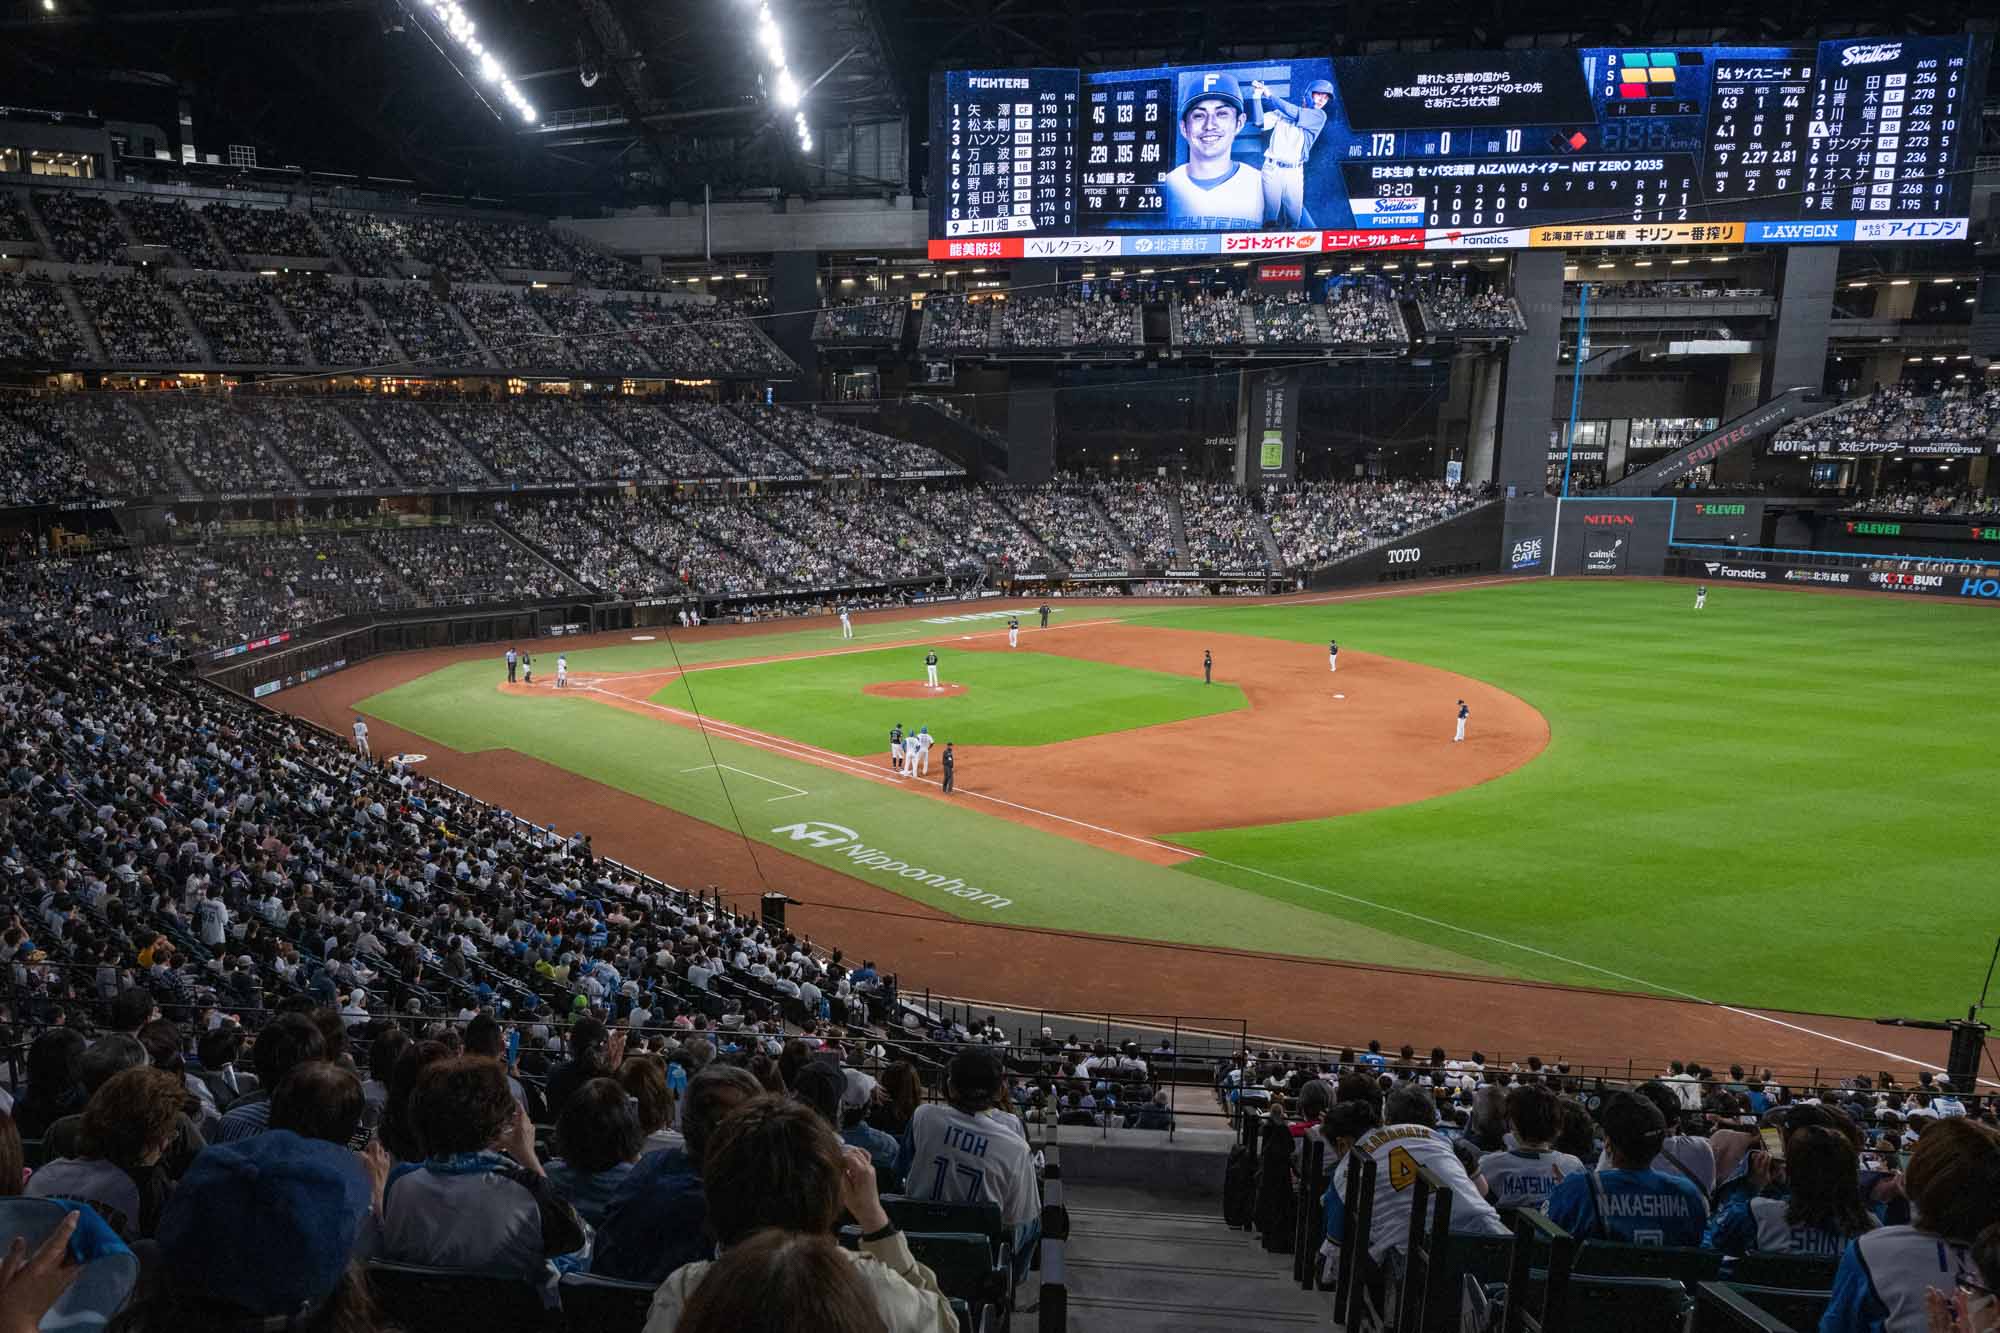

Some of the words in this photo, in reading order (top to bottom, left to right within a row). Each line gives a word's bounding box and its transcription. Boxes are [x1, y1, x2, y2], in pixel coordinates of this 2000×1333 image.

[1608, 55, 1616, 65] B
[1841, 45, 1901, 66] Swallows
[1917, 60, 1937, 69] AVG
[1949, 58, 1963, 67] HR
[1607, 70, 1615, 81] S
[1717, 68, 1731, 80] 54
[1734, 67, 1792, 79] サイスニード
[1913, 72, 1937, 84] .256
[968, 78, 1030, 89] FIGHTERS
[1203, 73, 1220, 92] F
[1718, 87, 1744, 95] PITCHES
[1755, 87, 1770, 95] HITS
[1780, 86, 1806, 94] STRIKES
[1911, 88, 1936, 100] .278
[1722, 97, 1738, 109] 63
[1783, 95, 1799, 108] 44
[1038, 104, 1057, 114] .190
[1092, 106, 1105, 124] 45
[1117, 104, 1133, 123] 133
[1145, 103, 1158, 122] 23
[1909, 104, 1934, 116] .452
[1038, 118, 1057, 129] .290
[1716, 124, 1735, 137] 4.1
[1753, 123, 1762, 137] 0
[1907, 120, 1931, 132] .224
[1941, 120, 1955, 131] 10
[968, 134, 1010, 146] ハンソン
[1038, 132, 1057, 143] .115
[1349, 145, 1363, 157] AVG
[1367, 133, 1395, 157] .173
[1440, 131, 1451, 154] 0
[1505, 129, 1521, 153] 10
[1828, 138, 1873, 151] サンタナ
[1905, 136, 1929, 147] .273
[1037, 146, 1056, 157] .257
[1064, 146, 1073, 156] 11
[1714, 143, 1736, 151] GAMES
[1088, 146, 1108, 164] .229
[1114, 144, 1133, 163] .195
[1140, 144, 1160, 162] .464
[1720, 152, 1728, 165] 9
[1741, 151, 1768, 164] 2.27
[1772, 150, 1797, 163] 2.81
[1903, 152, 1927, 163] .236
[1037, 161, 1056, 171] .313
[1372, 166, 1415, 178] 日本生命
[1477, 162, 1570, 175] AIZAWAナイター
[1572, 161, 1596, 173] NET
[1598, 160, 1631, 172] ZERO
[1634, 159, 1664, 171] 2035
[1083, 173, 1094, 184] 14
[1745, 170, 1761, 178] LOSE
[1775, 168, 1792, 176] SAVE
[1824, 168, 1870, 181] オスナ
[1901, 168, 1925, 179] .264
[1037, 175, 1055, 185] .241
[1716, 180, 1725, 192] 3
[1747, 179, 1756, 191] 2
[1777, 178, 1786, 190] 0
[1036, 188, 1056, 198] .170
[1116, 187, 1129, 195] HITS
[1145, 187, 1157, 195] ERA
[1378, 183, 1413, 197] 19:20
[1899, 183, 1923, 194] .268
[1036, 202, 1055, 212] .174
[1088, 197, 1102, 208] 78
[1119, 197, 1126, 208] 7
[1138, 196, 1162, 208] 2.18
[1374, 199, 1418, 213] Swallows
[1897, 199, 1921, 210] .195
[1036, 216, 1055, 226] .173
[1372, 215, 1419, 225] FIGHTERS
[1542, 230, 1626, 242] 北海道千歳工場産
[1762, 224, 1839, 238] LAWSON
[1153, 238, 1208, 251] 北洋銀行
[1226, 236, 1296, 250] シゴトガイド
[1463, 234, 1509, 245] Fanatics
[950, 242, 1002, 256] 能美防災
[1687, 423, 1753, 465] FUJITEC
[1838, 441, 1905, 452] 文化シャッター
[1695, 504, 1745, 515] 7-ELEVEN
[1584, 514, 1633, 526] NITTAN
[1846, 522, 1901, 536] 7-ELEVEN
[1513, 538, 1543, 554] ASK
[1387, 549, 1421, 564] TOTO
[1511, 549, 1542, 563] GATE
[1721, 566, 1767, 579] Fanatics
[1880, 572, 1943, 587] KOTOBUKI
[1960, 577, 2000, 597] HO
[833, 843, 1013, 909] Nipponham
[944, 1126, 989, 1158] ITOH
[929, 1155, 983, 1203] 17
[1599, 1194, 1690, 1217] NAKASHIMA
